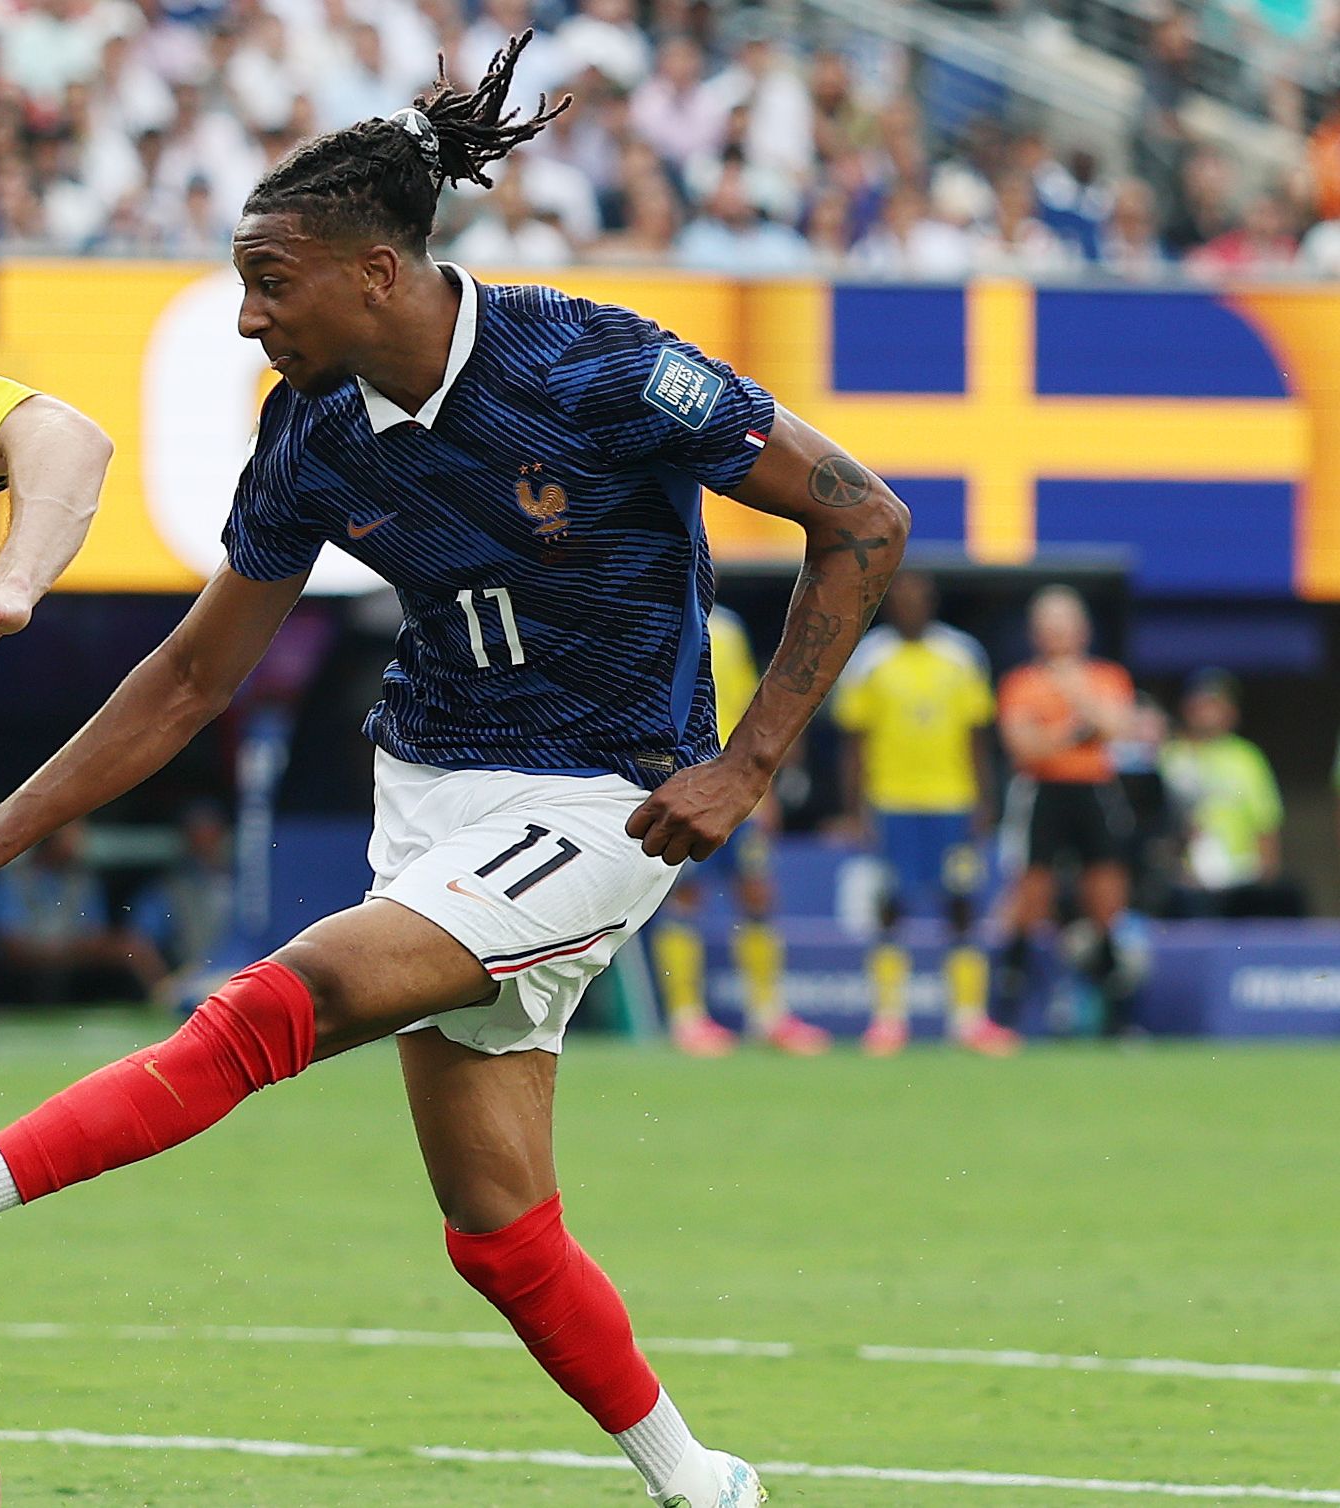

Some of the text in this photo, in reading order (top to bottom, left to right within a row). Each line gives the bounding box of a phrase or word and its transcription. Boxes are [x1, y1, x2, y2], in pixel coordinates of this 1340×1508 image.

[655, 359, 681, 399] FOOTBALL
[664, 364, 694, 406] UNITES
[678, 398, 694, 416] the
[695, 391, 709, 410] FIFA
[456, 588, 525, 668] 11
[473, 822, 582, 901] 11
